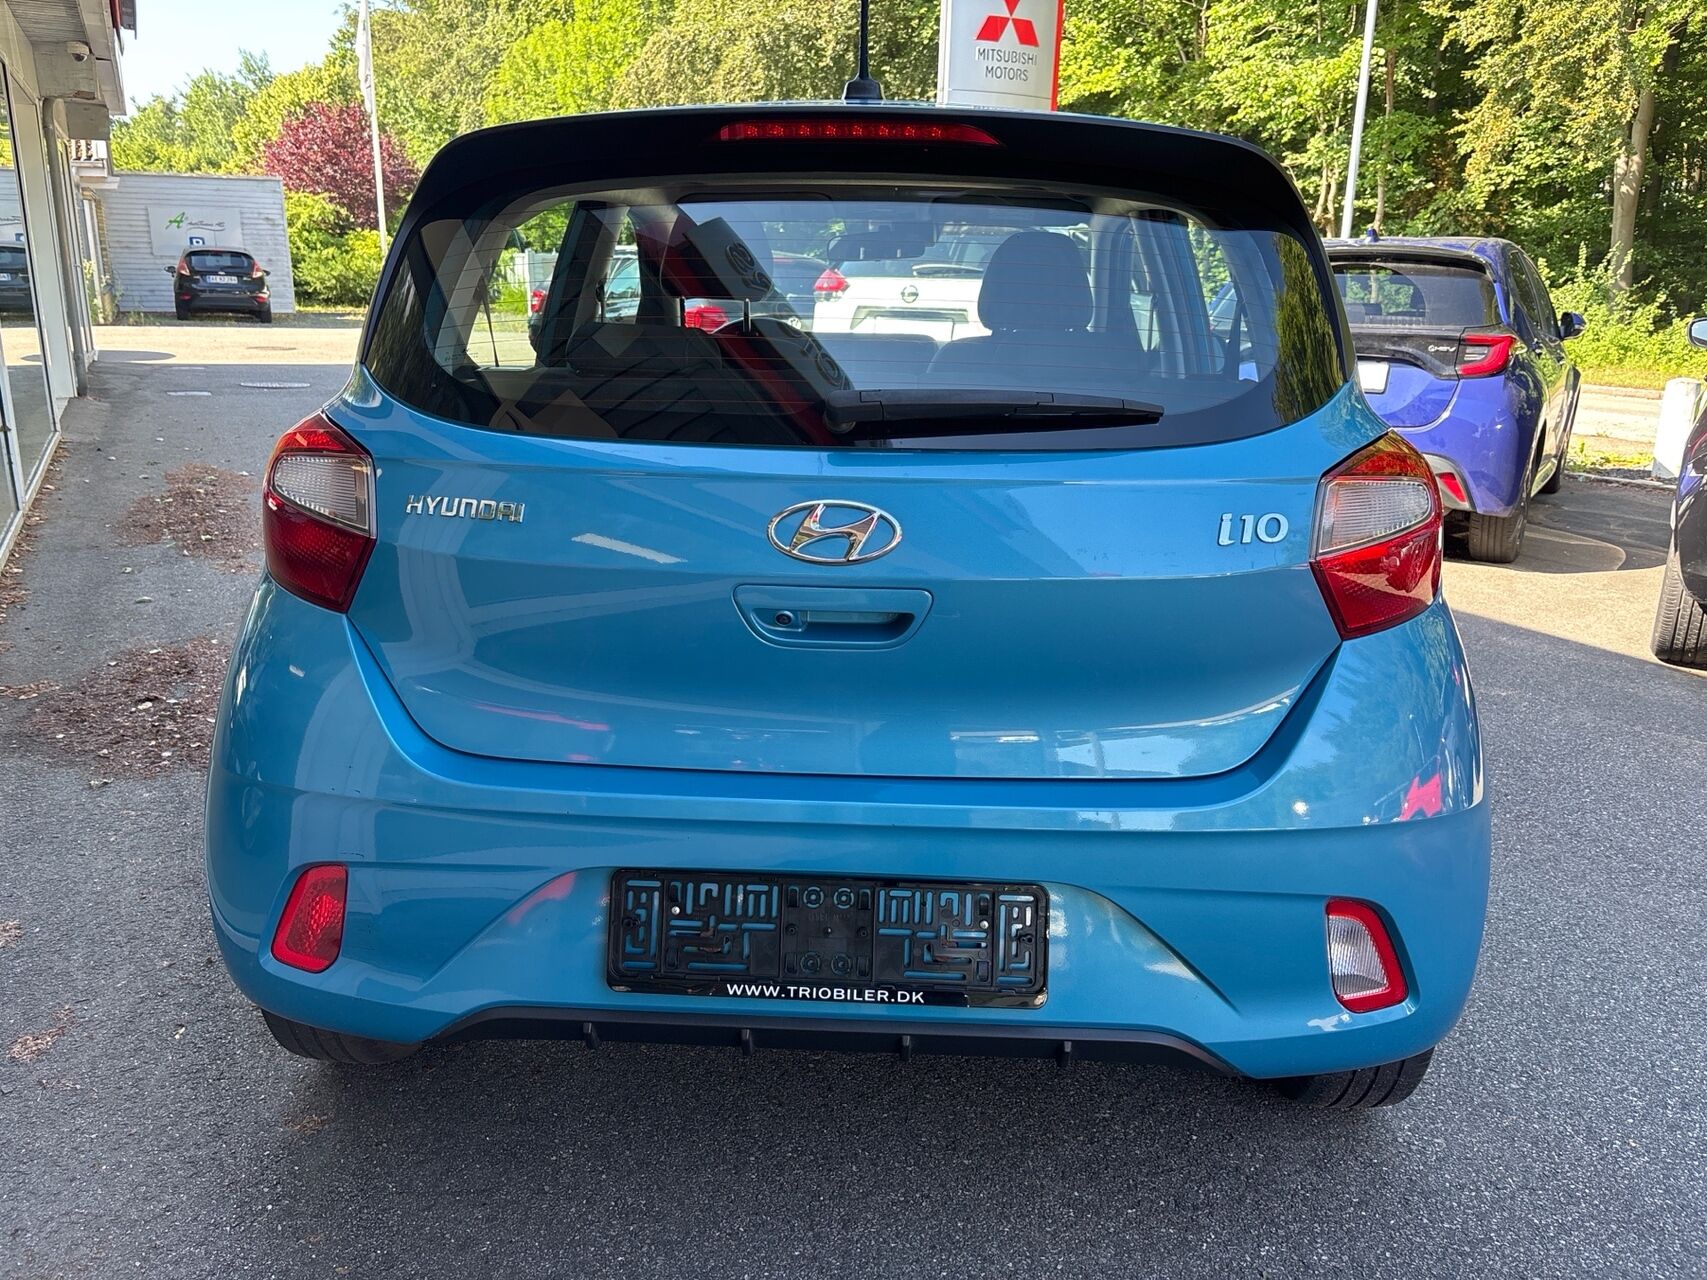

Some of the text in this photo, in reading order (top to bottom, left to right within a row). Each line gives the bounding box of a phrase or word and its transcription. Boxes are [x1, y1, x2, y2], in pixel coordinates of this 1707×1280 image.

[976, 47, 1038, 66] MITSUBISHI
[985, 65, 1029, 82] MOTORS
[405, 494, 526, 523] HYUNDAI
[1217, 512, 1289, 546] i10
[726, 983, 925, 1004] WWW.TRIOBILER.DK
